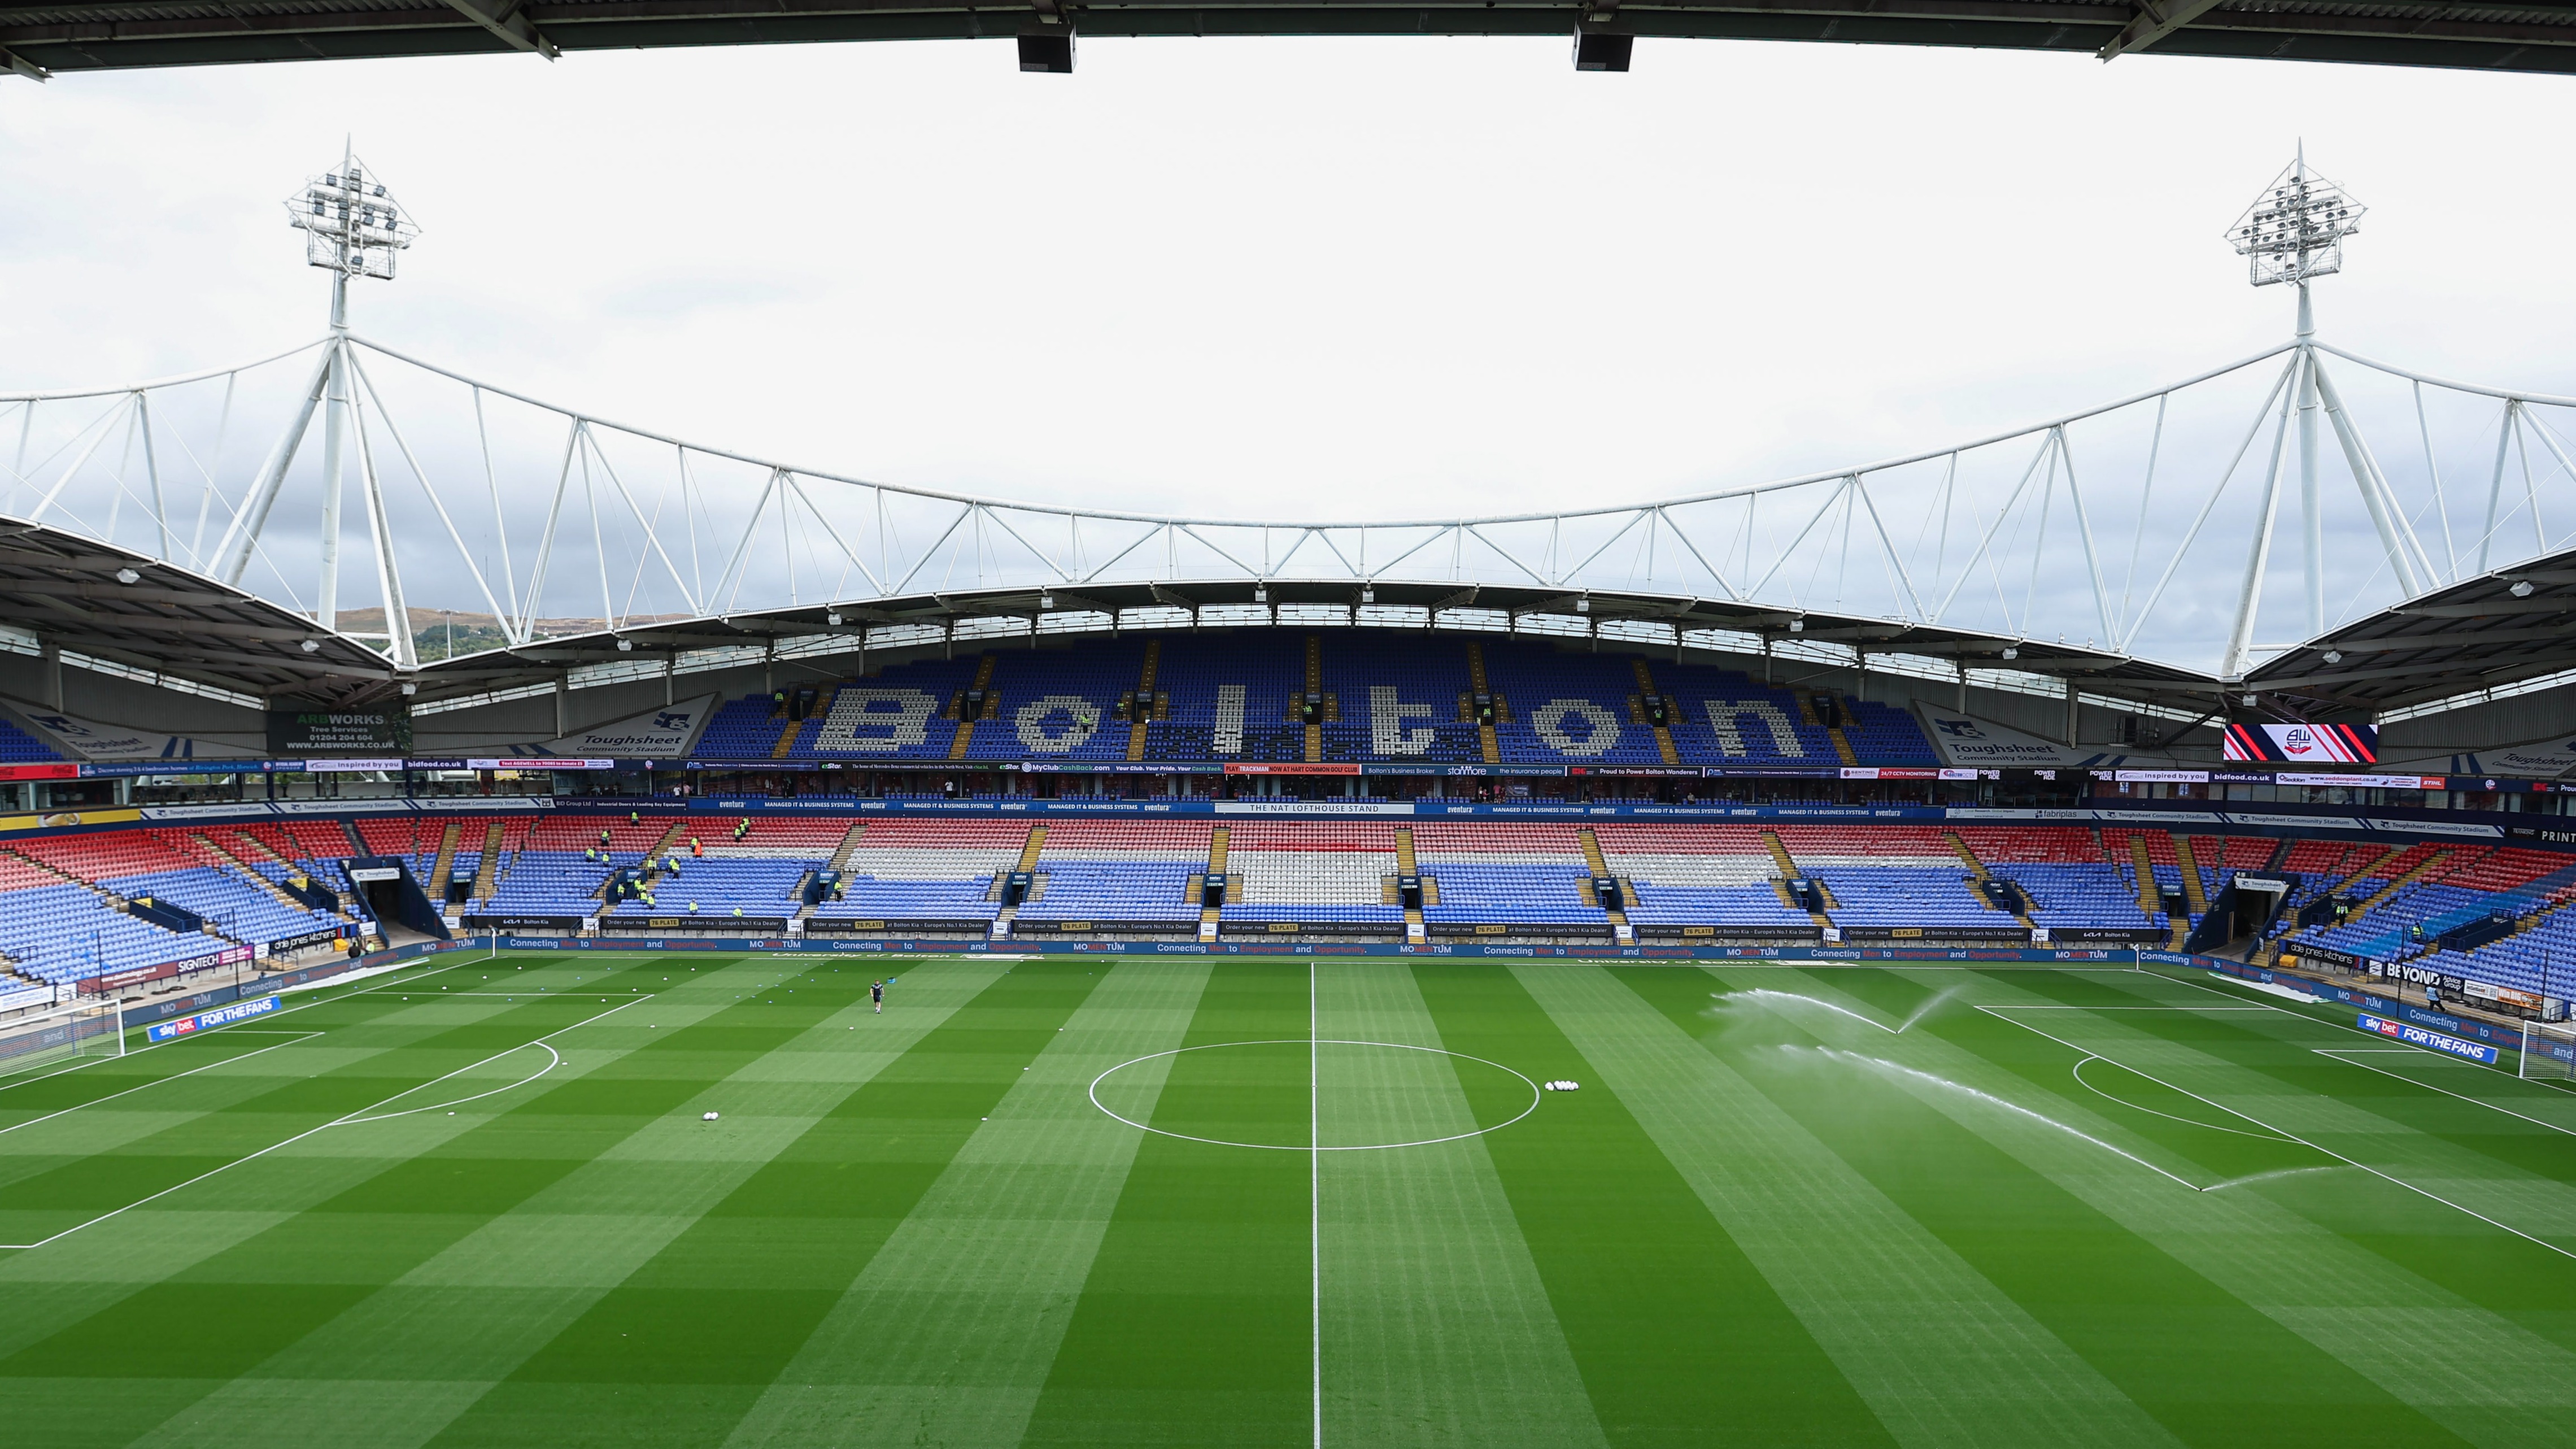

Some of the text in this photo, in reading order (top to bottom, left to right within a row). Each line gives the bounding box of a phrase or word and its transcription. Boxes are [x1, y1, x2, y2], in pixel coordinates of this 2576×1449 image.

[297, 715, 384, 724] ARBWORKS
[813, 684, 1804, 758] Bolton
[585, 736, 682, 746] Toughsheet
[1949, 744, 2055, 754] Toughsheet
[2504, 753, 2576, 765] Toughsheet
[1448, 766, 1487, 775] stanmore
[2492, 761, 2531, 772] Community
[2178, 773, 2188, 781] by
[2044, 810, 2077, 819] fabriplas
[2542, 831, 2576, 842] PRINT
[1484, 947, 1533, 956] Connecting
[1641, 948, 1694, 958] Opportunity.
[2291, 943, 2353, 964] dale jones kitchens
[178, 954, 219, 972] SIGNTECH
[2387, 963, 2440, 985] BEYOND
[2443, 975, 2461, 985] Advice
[2444, 980, 2463, 990] Group
[159, 1000, 272, 1036] sky bet FOR THE FANS
[2410, 1009, 2488, 1037] Connecting to
[2366, 1018, 2485, 1058] sky bet FOR THE FANS
